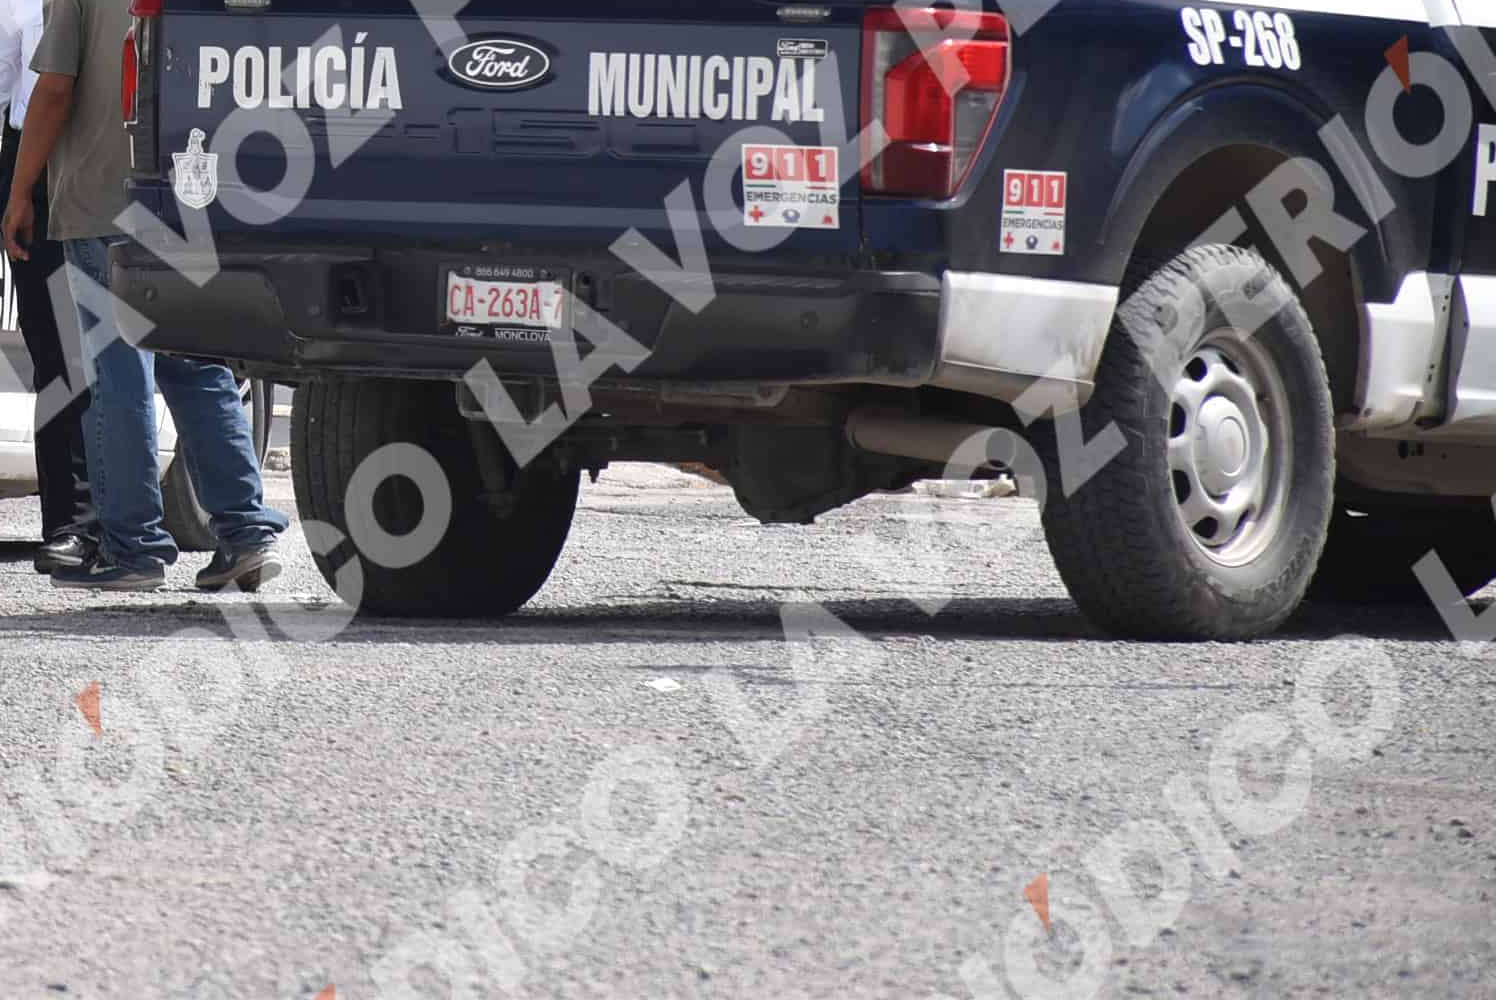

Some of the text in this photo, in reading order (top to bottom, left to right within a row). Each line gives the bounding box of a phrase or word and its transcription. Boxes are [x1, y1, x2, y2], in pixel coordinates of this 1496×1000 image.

[1181, 7, 1301, 70] SP-268
[197, 32, 825, 122] POLICÍA MUNICIPAL
[749, 151, 829, 178] 911
[746, 191, 838, 204] EMERGENCIAS
[1008, 178, 1061, 203] 911
[450, 284, 563, 320] CA-263A-7
[495, 331, 552, 342] MONCLOVA
